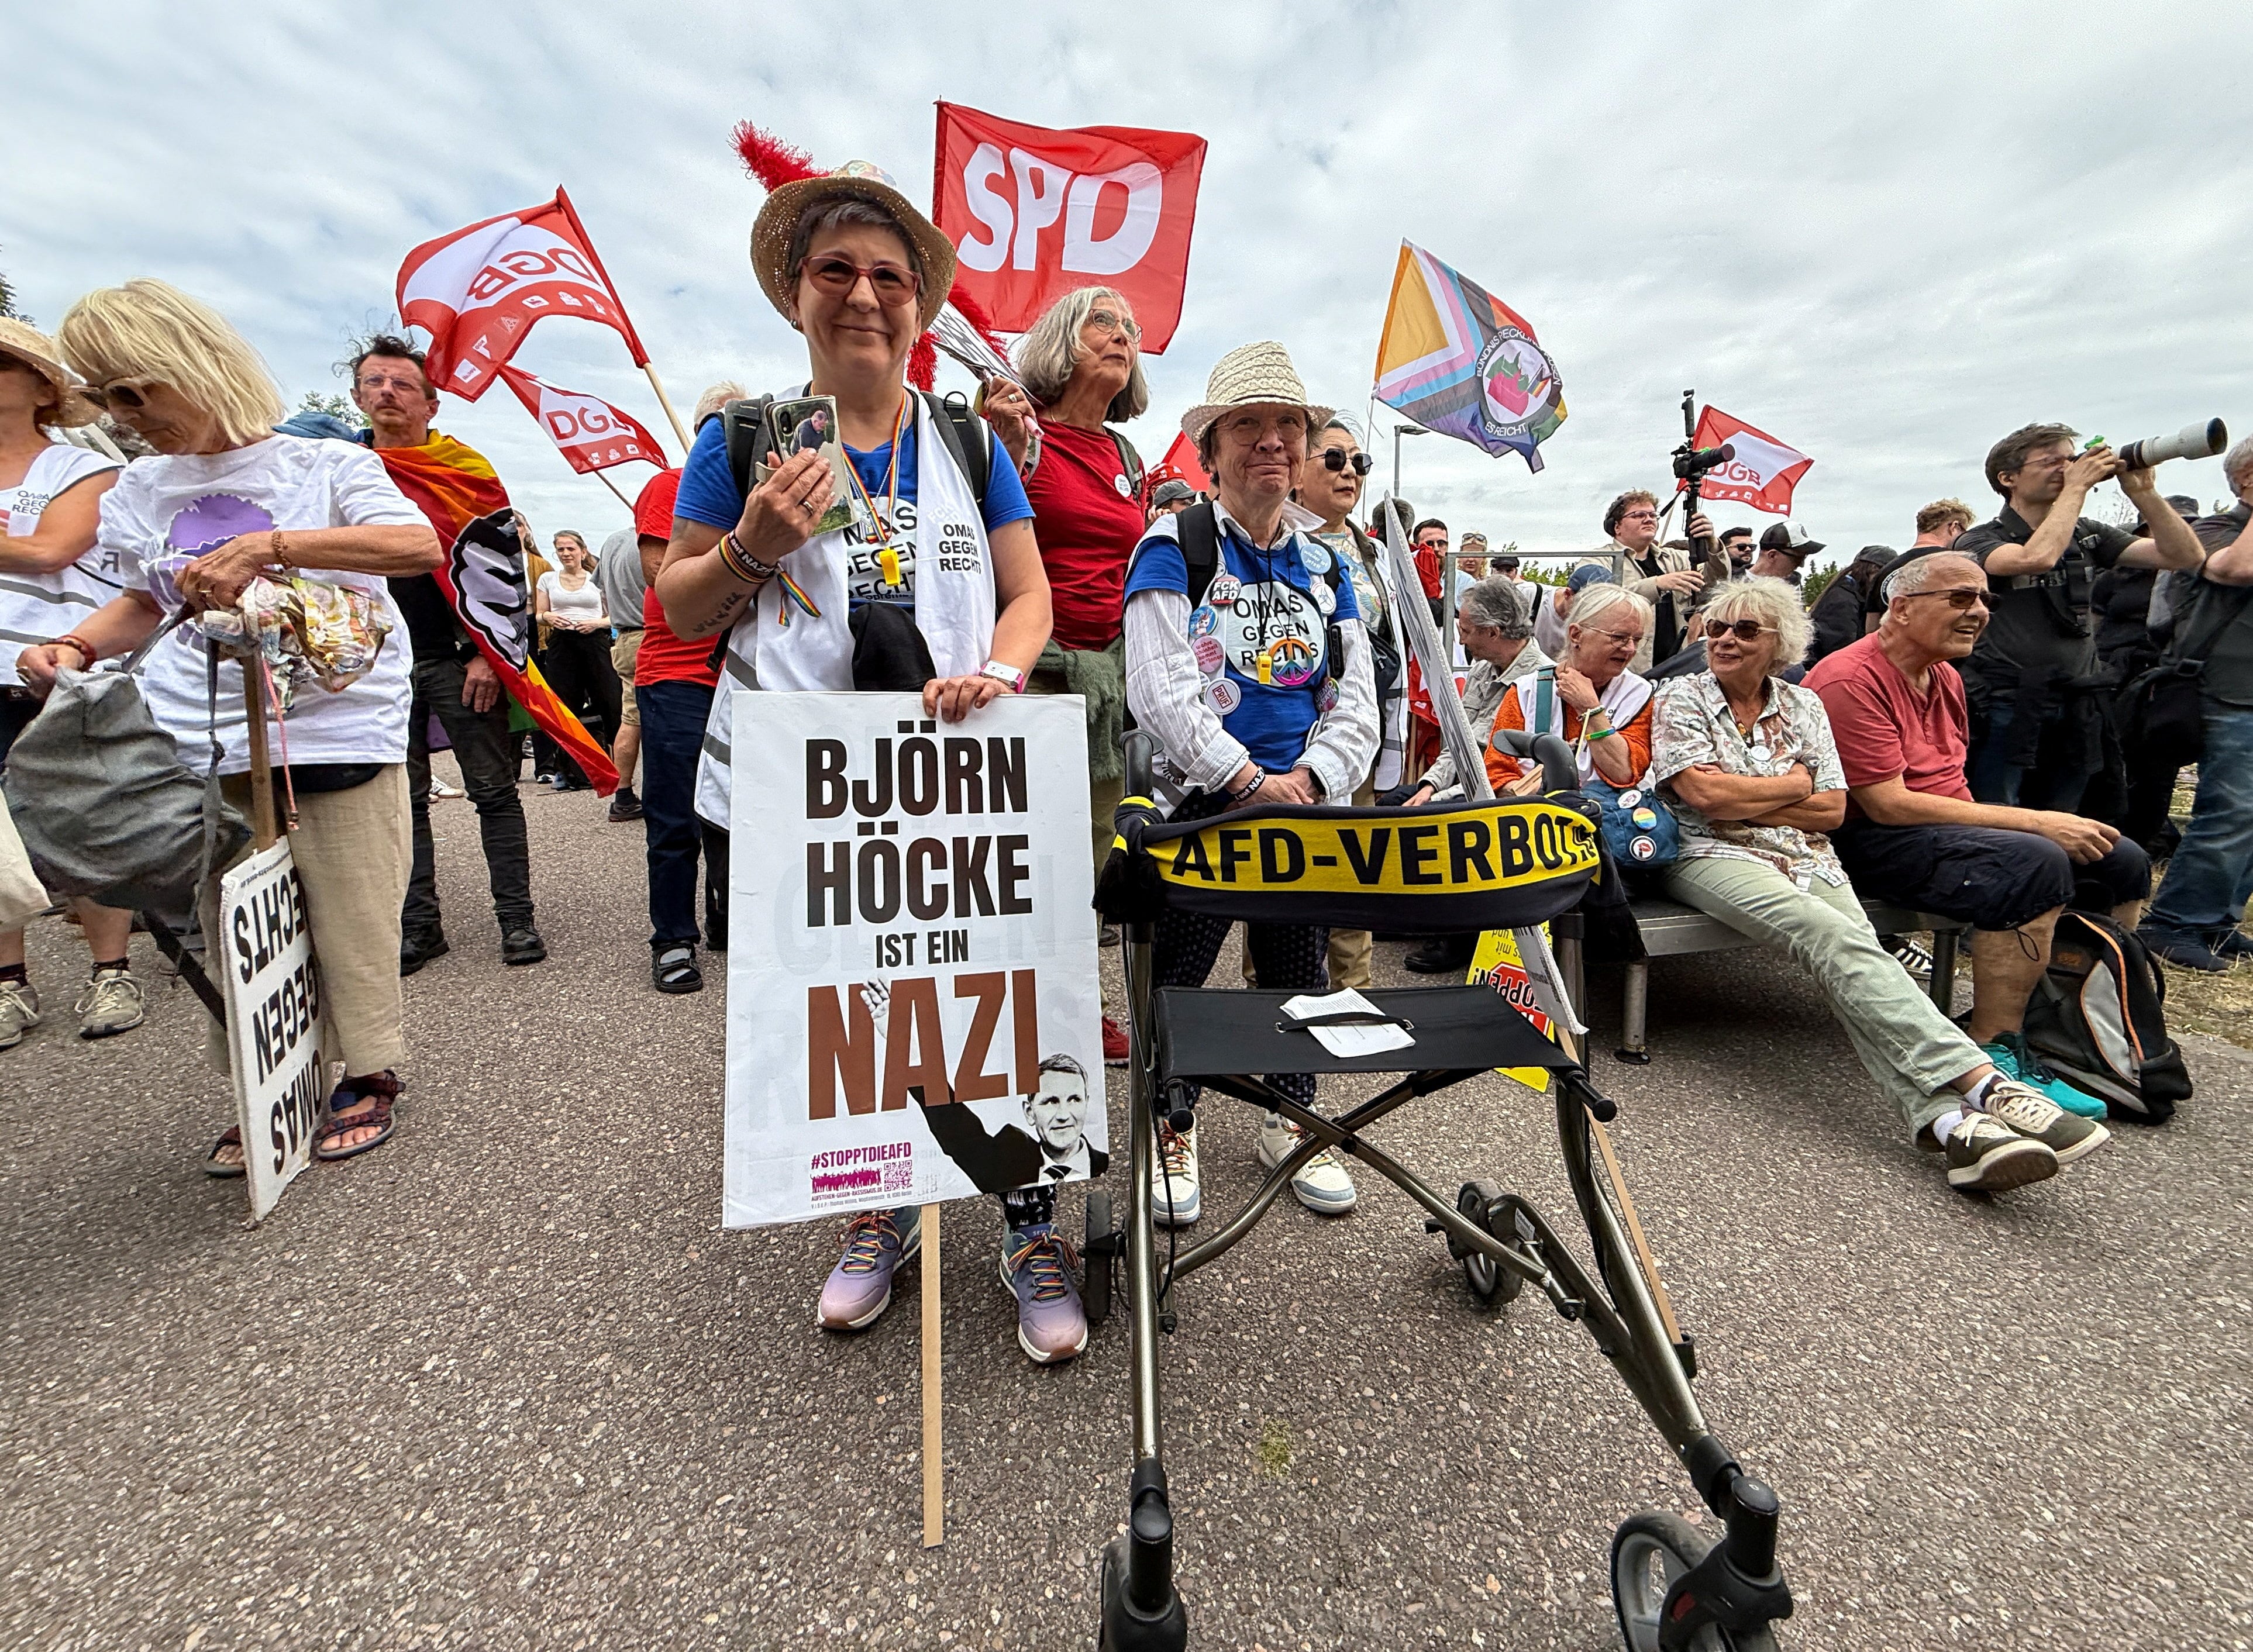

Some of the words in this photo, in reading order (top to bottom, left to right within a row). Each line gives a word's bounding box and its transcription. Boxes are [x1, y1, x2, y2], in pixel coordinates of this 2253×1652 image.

[956, 142, 1162, 275] SPD
[1484, 422, 1496, 434] ES
[1494, 421, 1529, 437] REICHT
[842, 506, 918, 546] MAS
[943, 523, 975, 540] OMAS
[938, 540, 978, 556] GEGEN
[939, 557, 981, 575] RECHTS
[1211, 591, 1238, 601] AFD
[1213, 581, 1239, 591] FCK
[1233, 594, 1304, 619] OMAS
[1215, 687, 1230, 707] PRÜF
[805, 720, 1029, 819] BJÖRN
[807, 821, 1033, 928] HÖCKE
[233, 864, 306, 985] ECHTS
[876, 933, 916, 969] IST
[928, 929, 969, 964] EIN
[252, 952, 320, 1087] GEGEN
[808, 968, 1040, 1121] NAZI
[271, 1049, 323, 1175] OMAS
[811, 1141, 912, 1170] #STOPPTDIEAFD
